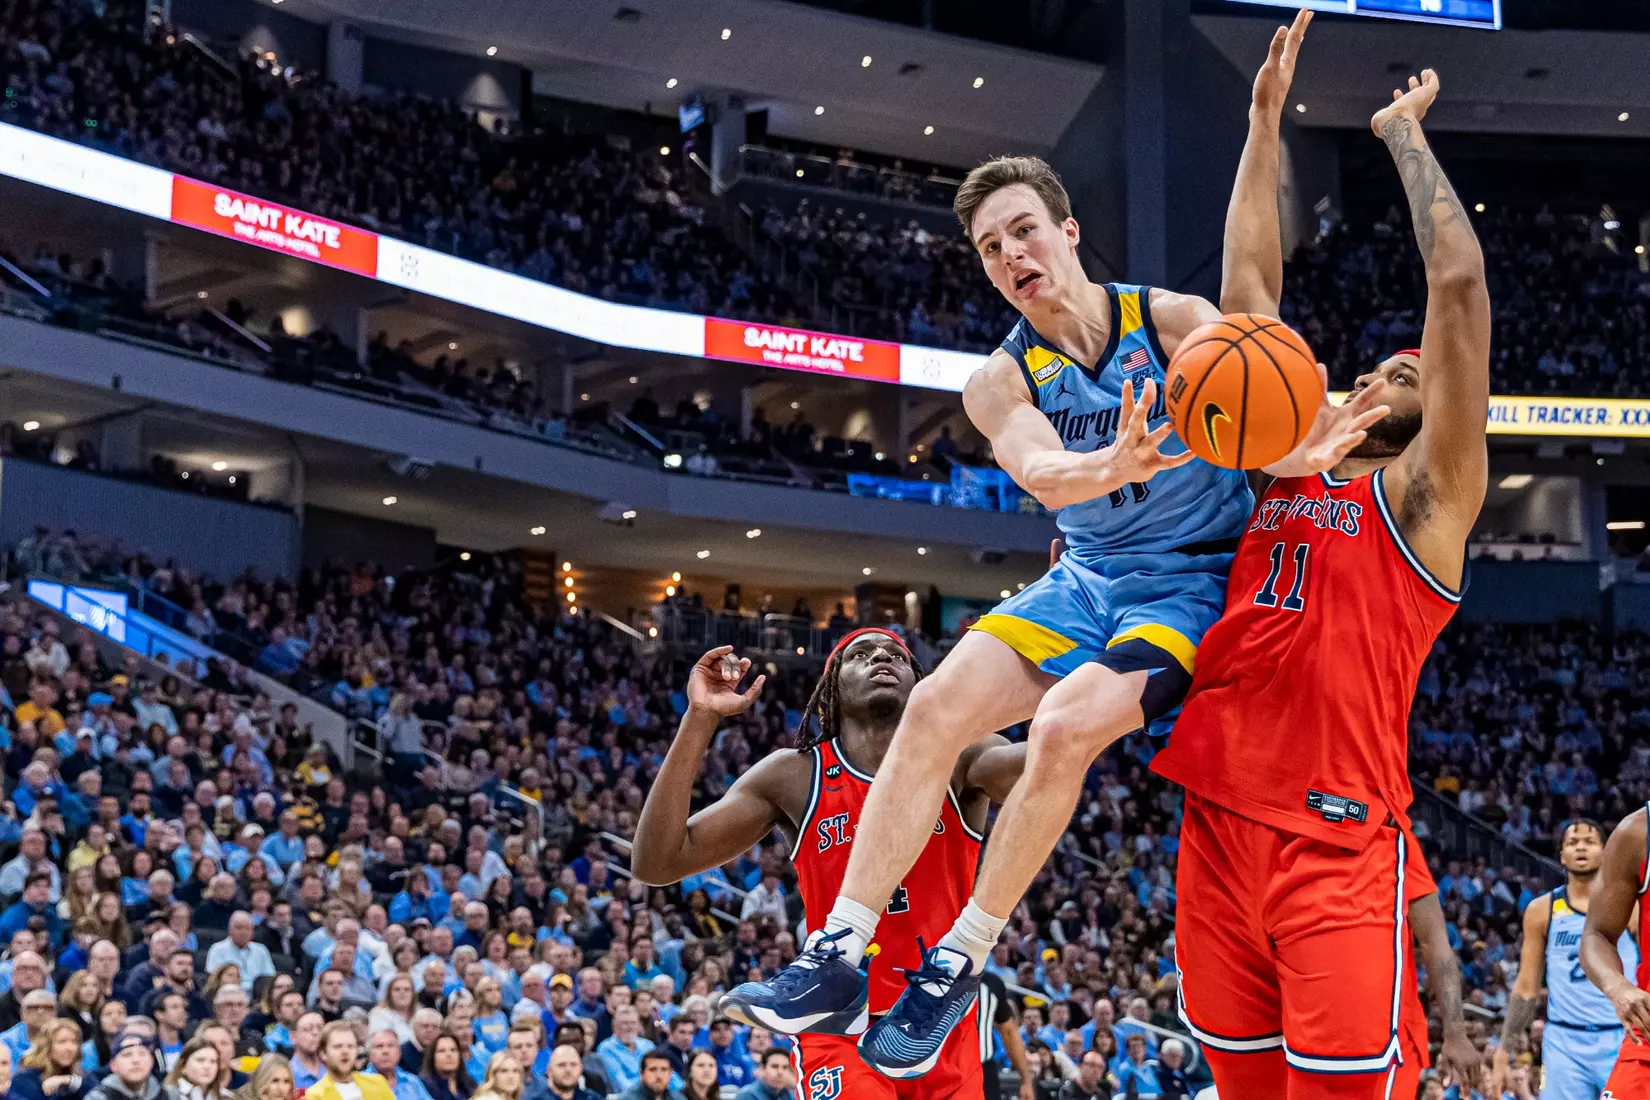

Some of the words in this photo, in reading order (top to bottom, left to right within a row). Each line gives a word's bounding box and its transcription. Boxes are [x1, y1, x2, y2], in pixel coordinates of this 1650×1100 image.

[214, 193, 283, 230] SAINT
[285, 214, 341, 249] KATE
[743, 327, 808, 353] SAINT
[810, 336, 864, 362] KATE
[762, 349, 783, 364] THE
[1488, 405, 1518, 423] KILL
[1253, 541, 1310, 612] 11
[826, 766, 840, 776] JK
[1348, 804, 1359, 815] 50
[817, 812, 852, 854] ST.
[808, 1064, 845, 1100] SJ
